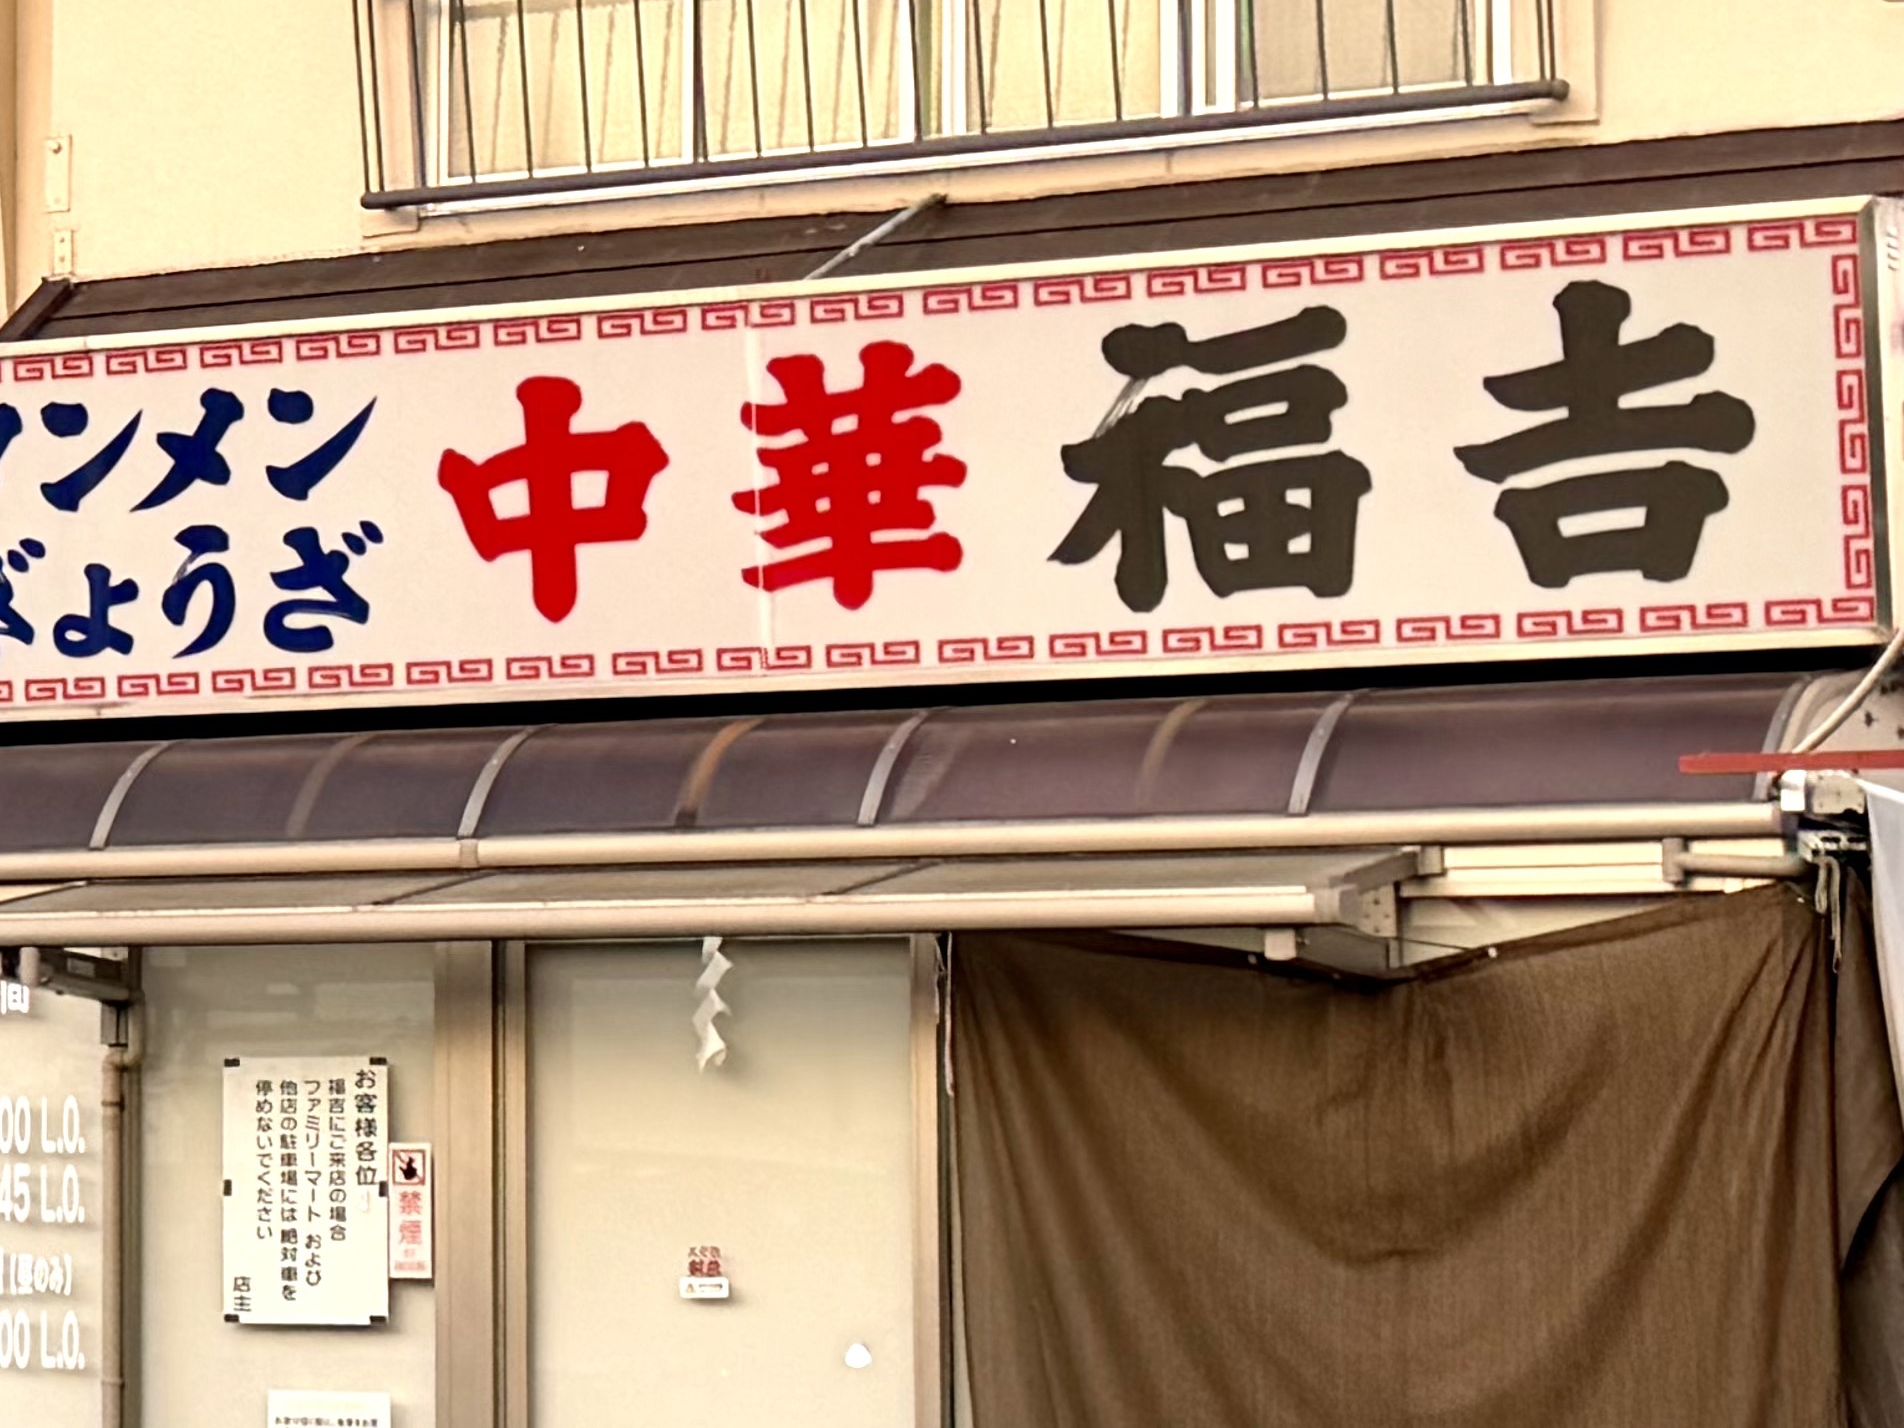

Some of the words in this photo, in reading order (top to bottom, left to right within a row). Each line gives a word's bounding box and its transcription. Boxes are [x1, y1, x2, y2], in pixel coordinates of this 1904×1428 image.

[437, 339, 968, 623] 中華
[1049, 280, 1756, 613] 福吉
[40, 1094, 85, 1155] L.O.
[255, 1079, 274, 1240] 停めないでください
[304, 1080, 322, 1223] ファミリーマート
[354, 1069, 378, 1186] お客様各位
[40, 1163, 85, 1224] L.O.
[40, 1308, 85, 1370] L.O.
